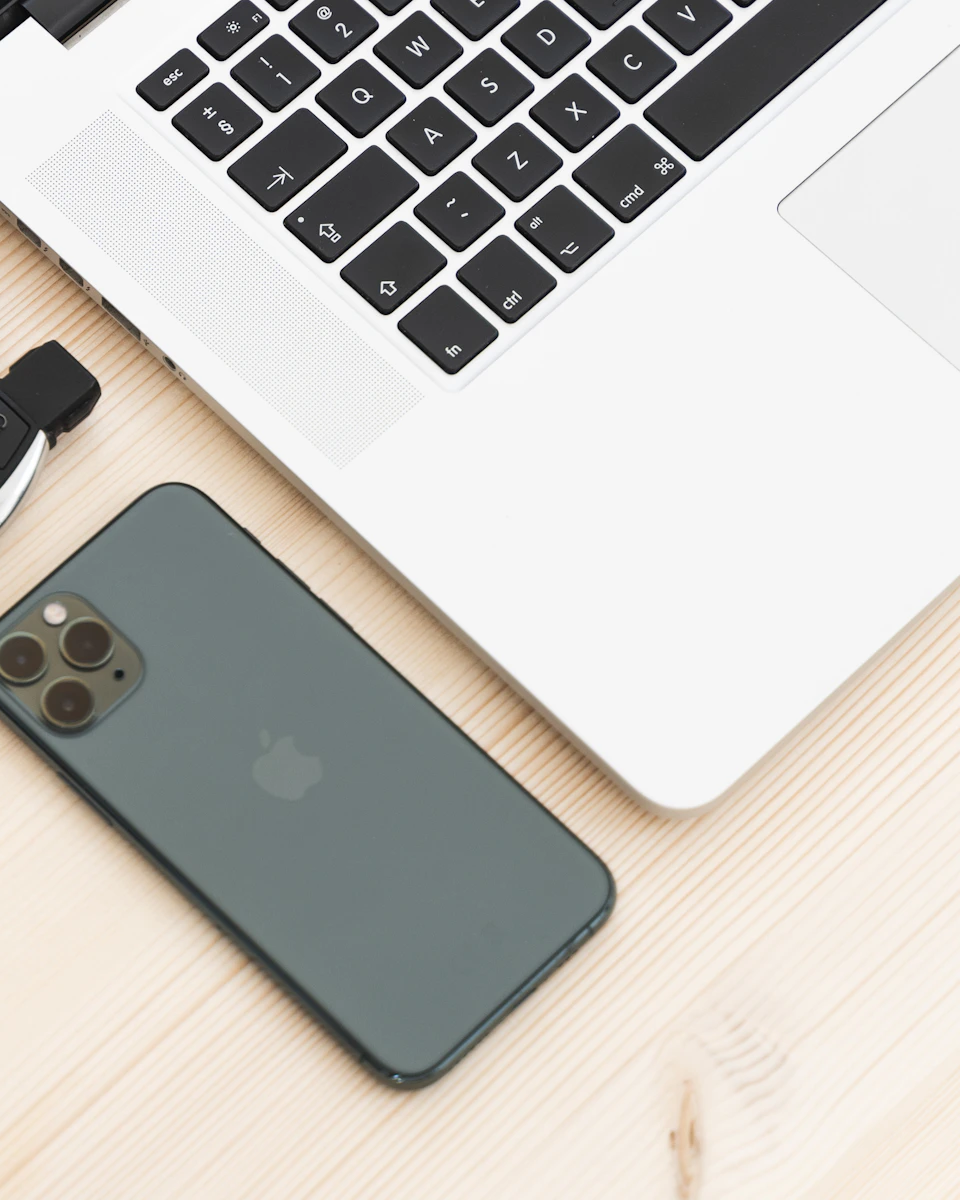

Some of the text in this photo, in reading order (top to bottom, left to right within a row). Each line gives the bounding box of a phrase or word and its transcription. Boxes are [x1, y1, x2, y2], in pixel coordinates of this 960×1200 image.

[252, 13, 263, 23] F1
[677, 5, 695, 21] V
[335, 23, 352, 38] 2
[537, 29, 555, 45] D
[406, 36, 429, 56] W
[624, 54, 642, 70] C
[163, 69, 183, 86] esc
[276, 73, 291, 84] 1
[481, 78, 498, 93] S
[352, 88, 373, 104] Q
[565, 102, 587, 121] X
[424, 128, 443, 144] A
[507, 151, 528, 170] Z
[620, 185, 644, 208] cmd
[530, 217, 542, 229] alt
[503, 290, 522, 309] ctrl
[445, 345, 462, 357] fn
